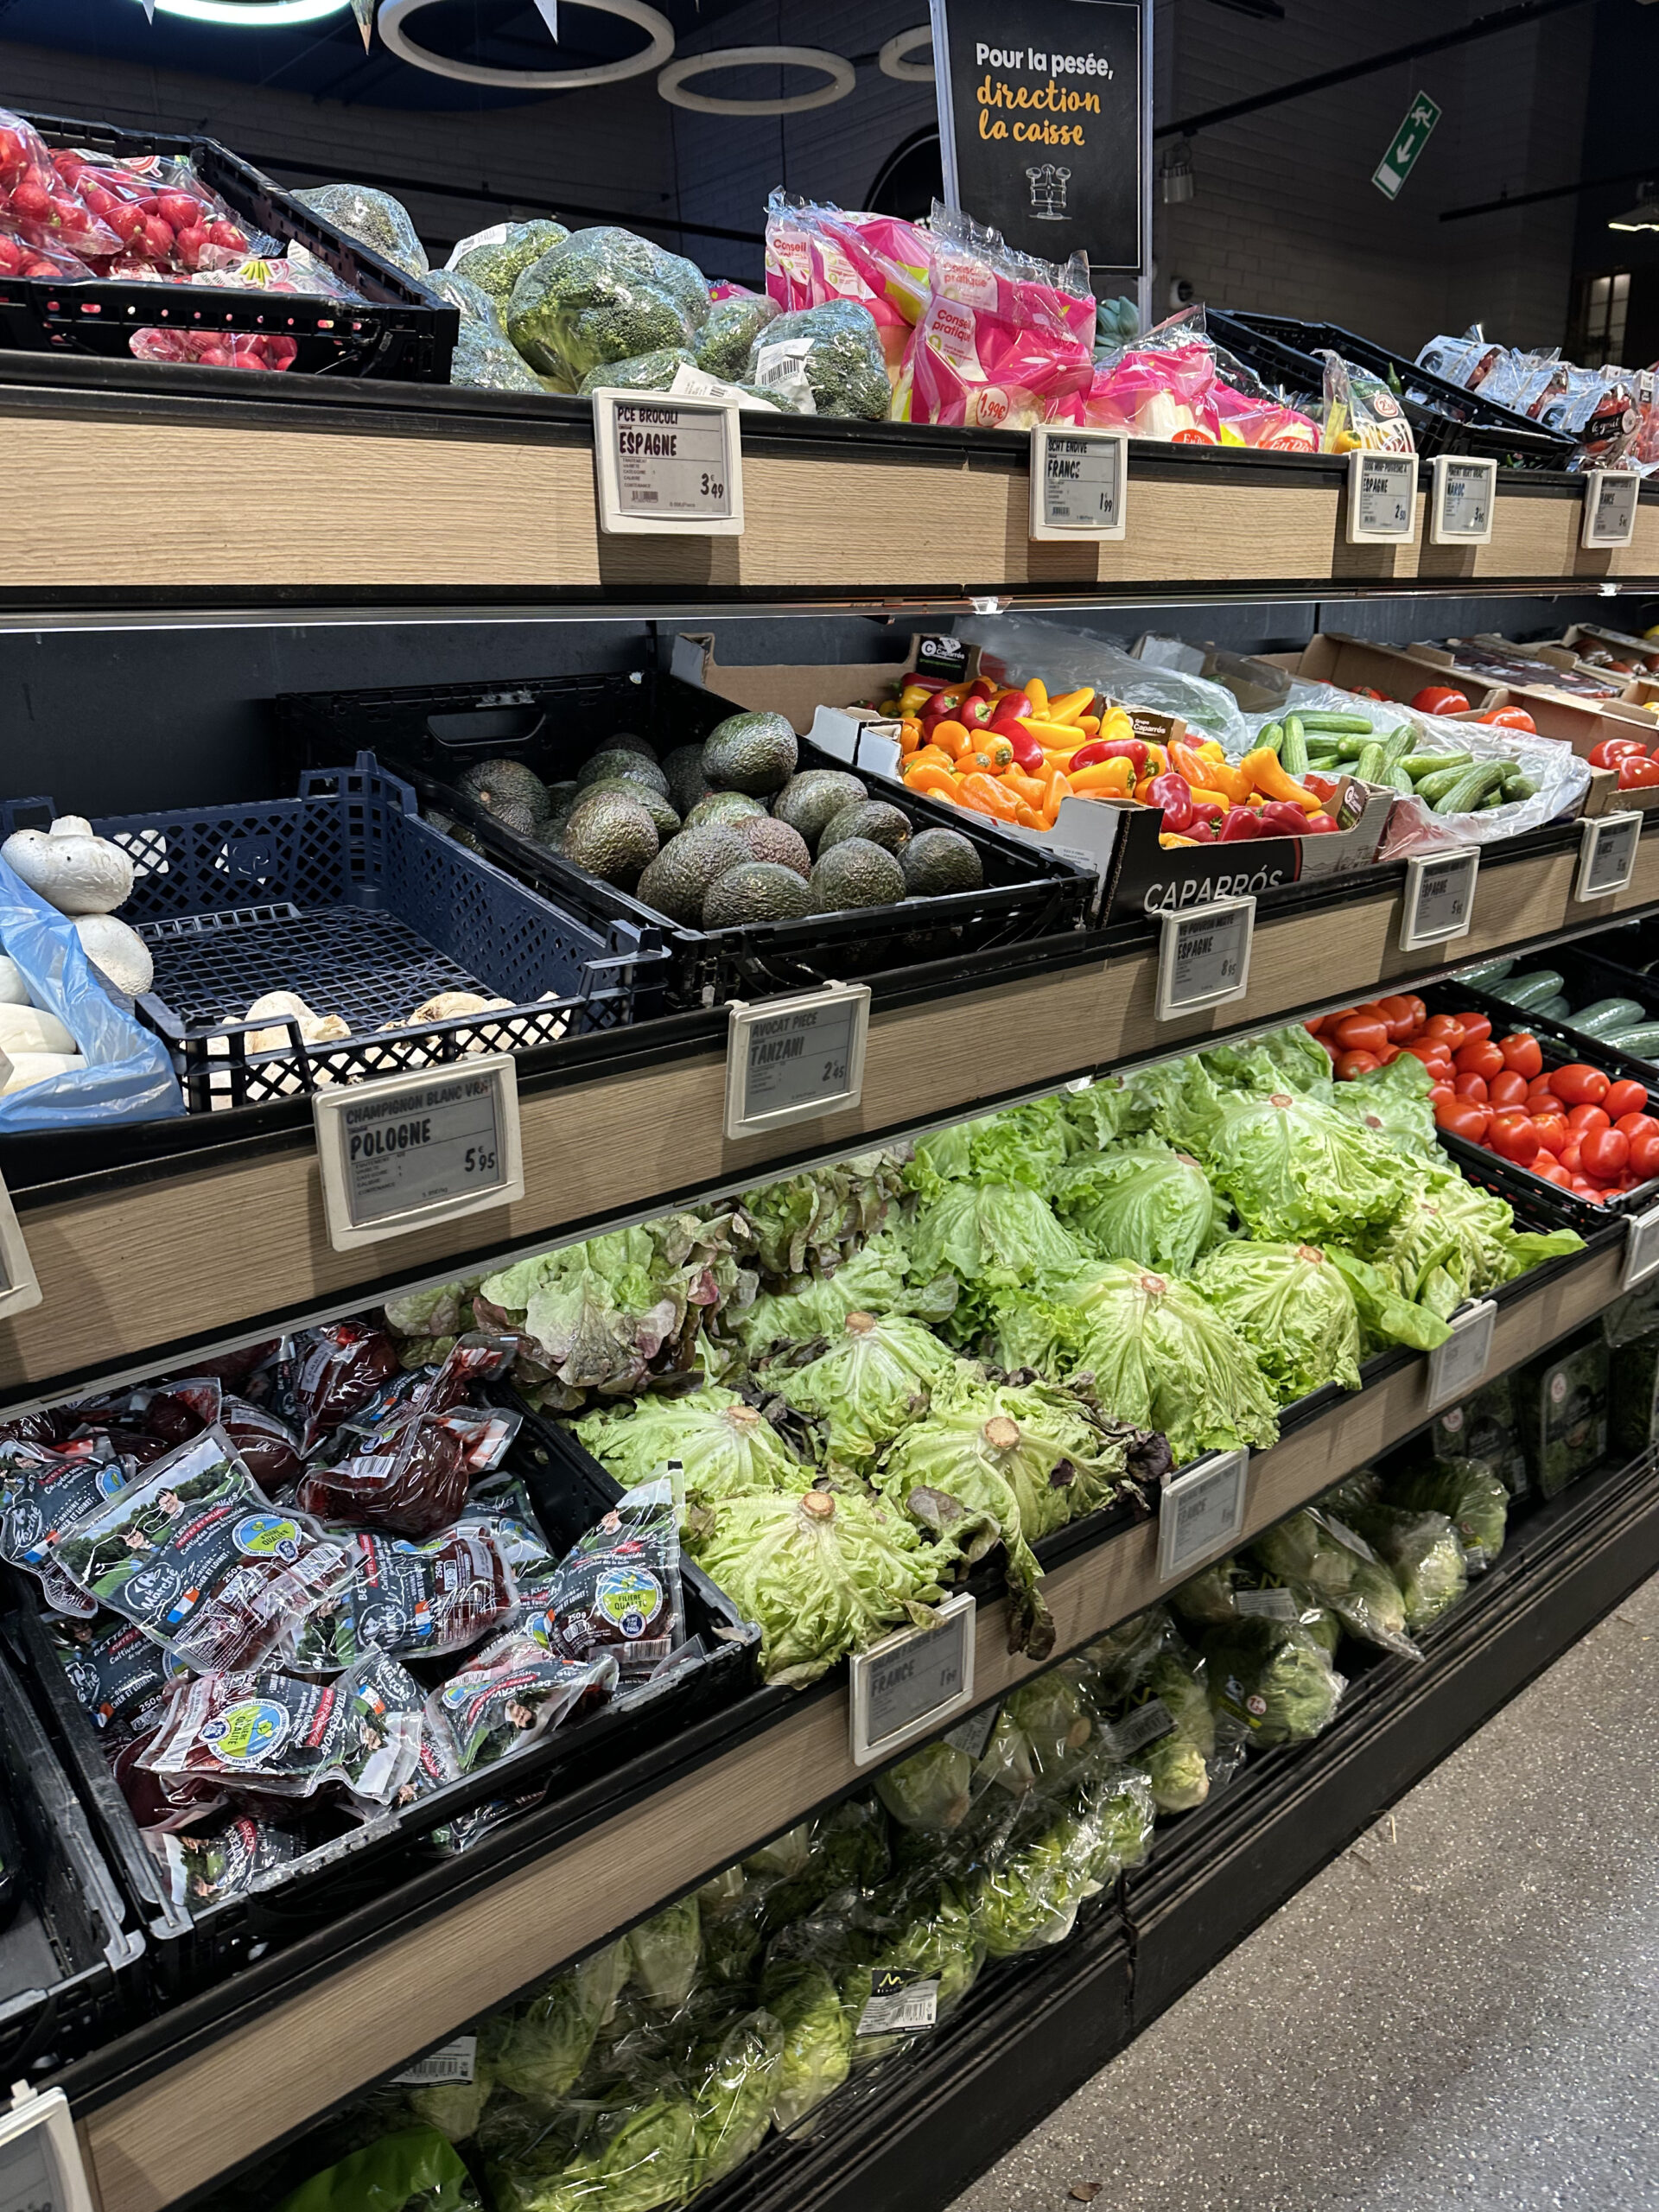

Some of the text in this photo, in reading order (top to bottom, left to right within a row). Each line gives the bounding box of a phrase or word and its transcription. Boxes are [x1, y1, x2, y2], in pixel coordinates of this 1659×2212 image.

[976, 42, 1114, 79] Pour la pesée,
[976, 74, 1101, 114] direction
[978, 109, 1085, 146] la caisse
[773, 238, 807, 252] Conseil
[938, 308, 971, 329] Conseil
[617, 406, 679, 425] PCE BROCOLI
[981, 393, 1006, 419] 1,99€
[619, 431, 677, 456] ESPAGNE
[1065, 441, 1088, 454] ENDIVE
[1048, 459, 1081, 479] FRANCE
[1363, 478, 1389, 493] ESPAGNE
[1134, 723, 1166, 734] Caparrós
[1143, 865, 1284, 912] CAPARRÓS
[1178, 936, 1214, 961] ESPAGNE
[752, 1011, 818, 1038] AVOCAT PIECE
[751, 1036, 804, 1066] TANZANI
[346, 1095, 423, 1124] CHAMPIGNON
[426, 1084, 462, 1105] BLANC
[350, 1118, 431, 1160] POLOGNE
[195, 1552, 230, 1592] CHER ET LOIRET
[196, 1558, 215, 1579] ORIGINE
[222, 1564, 245, 1585] 250g
[435, 1560, 443, 1579] 250g
[141, 1567, 179, 1611] Marché
[111, 1695, 127, 1709] CHER
[125, 1688, 134, 1698] ET
